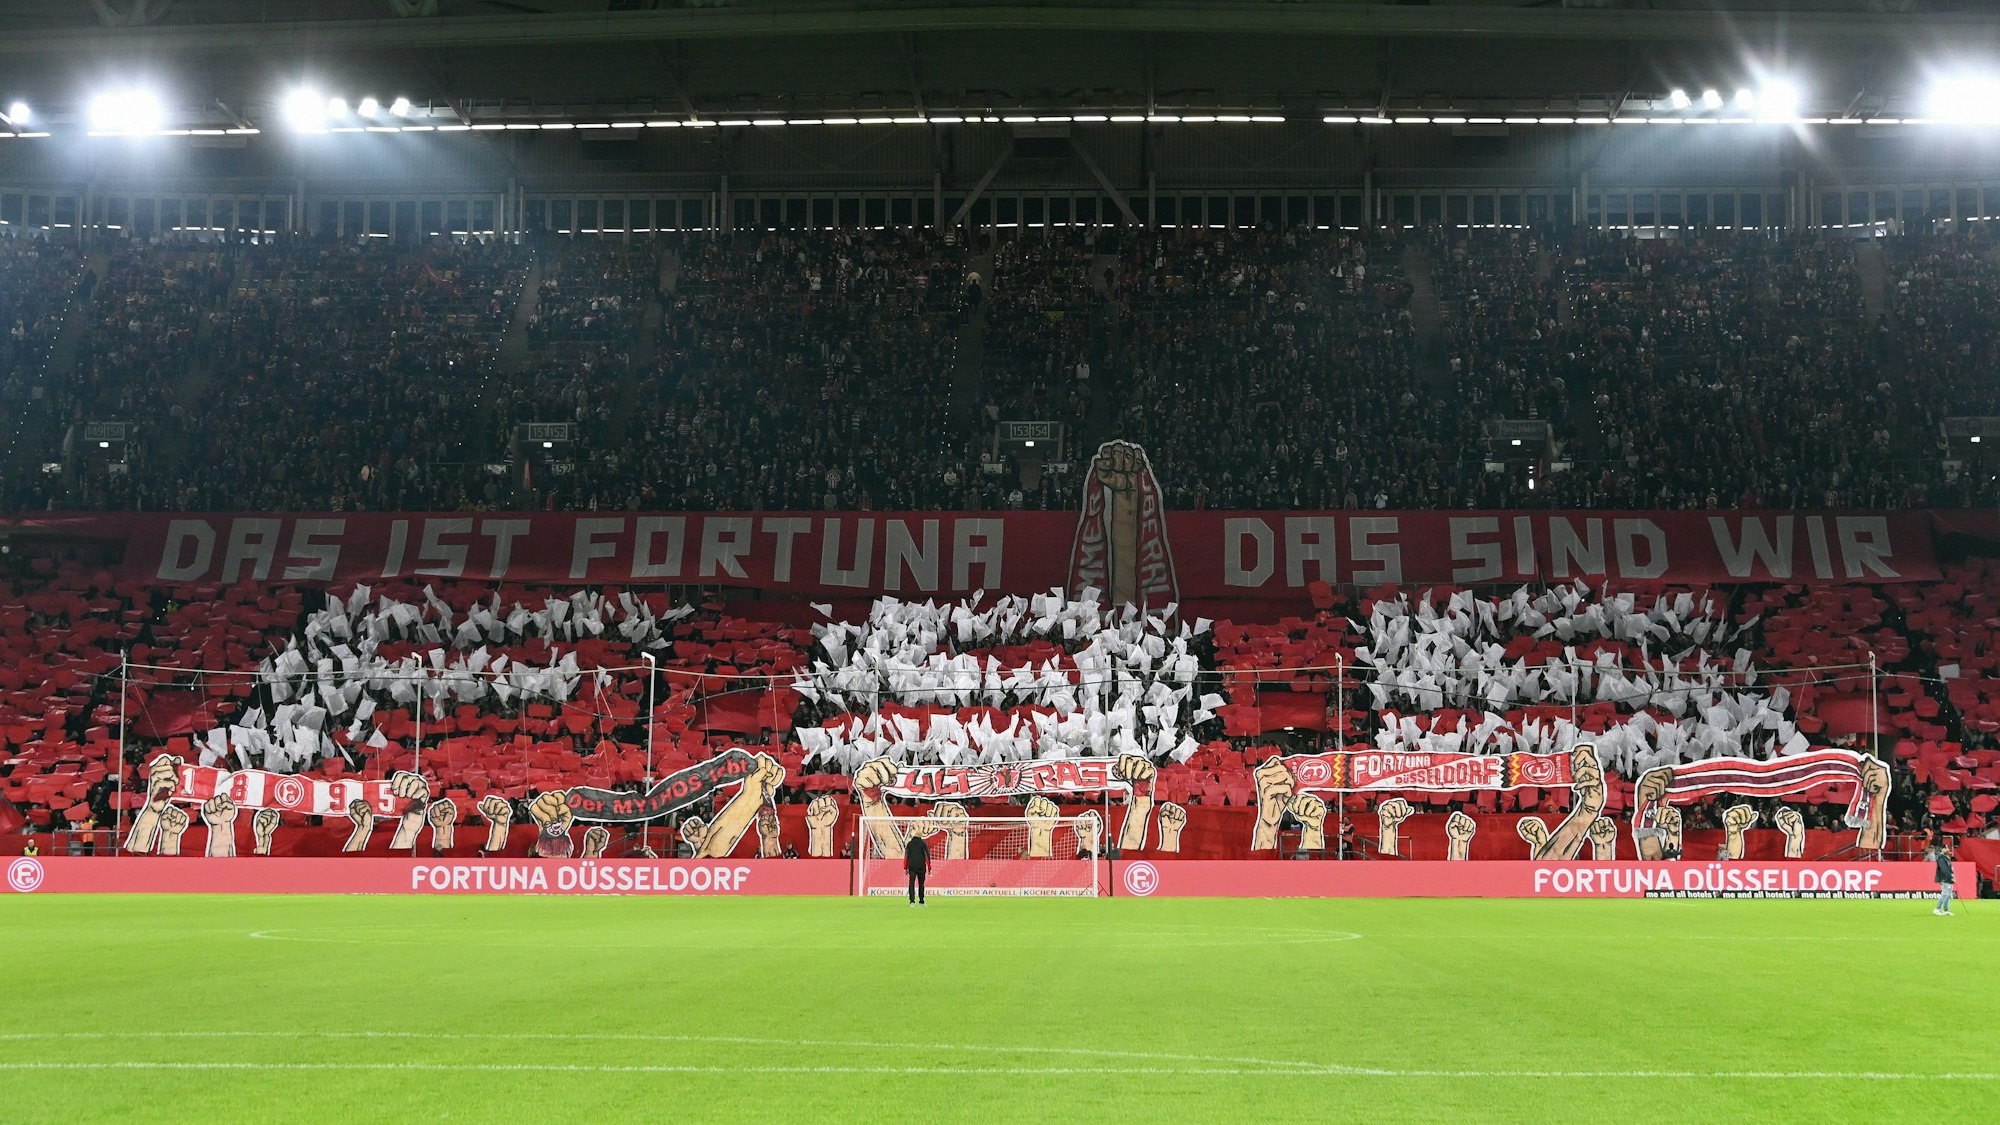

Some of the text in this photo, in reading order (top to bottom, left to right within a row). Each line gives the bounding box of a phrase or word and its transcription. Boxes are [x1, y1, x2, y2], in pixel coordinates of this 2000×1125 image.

[1012, 425, 1048, 437] 153 154
[156, 516, 1004, 591] DAS IST FORTUNA
[1224, 515, 1901, 587] DAS SIND WIR
[1353, 755, 1431, 784] FORTUNA
[1395, 757, 1500, 786] DÜSSELDORF
[567, 793, 604, 812] Der
[613, 774, 703, 814] MYTHOS
[412, 861, 751, 890] FORTUNA DÜSSELDORF
[1534, 863, 1883, 892] FORTUNA DÜSSELDORF
[870, 888, 904, 896] KÜCHEN
[947, 888, 980, 896] KÜCHEN
